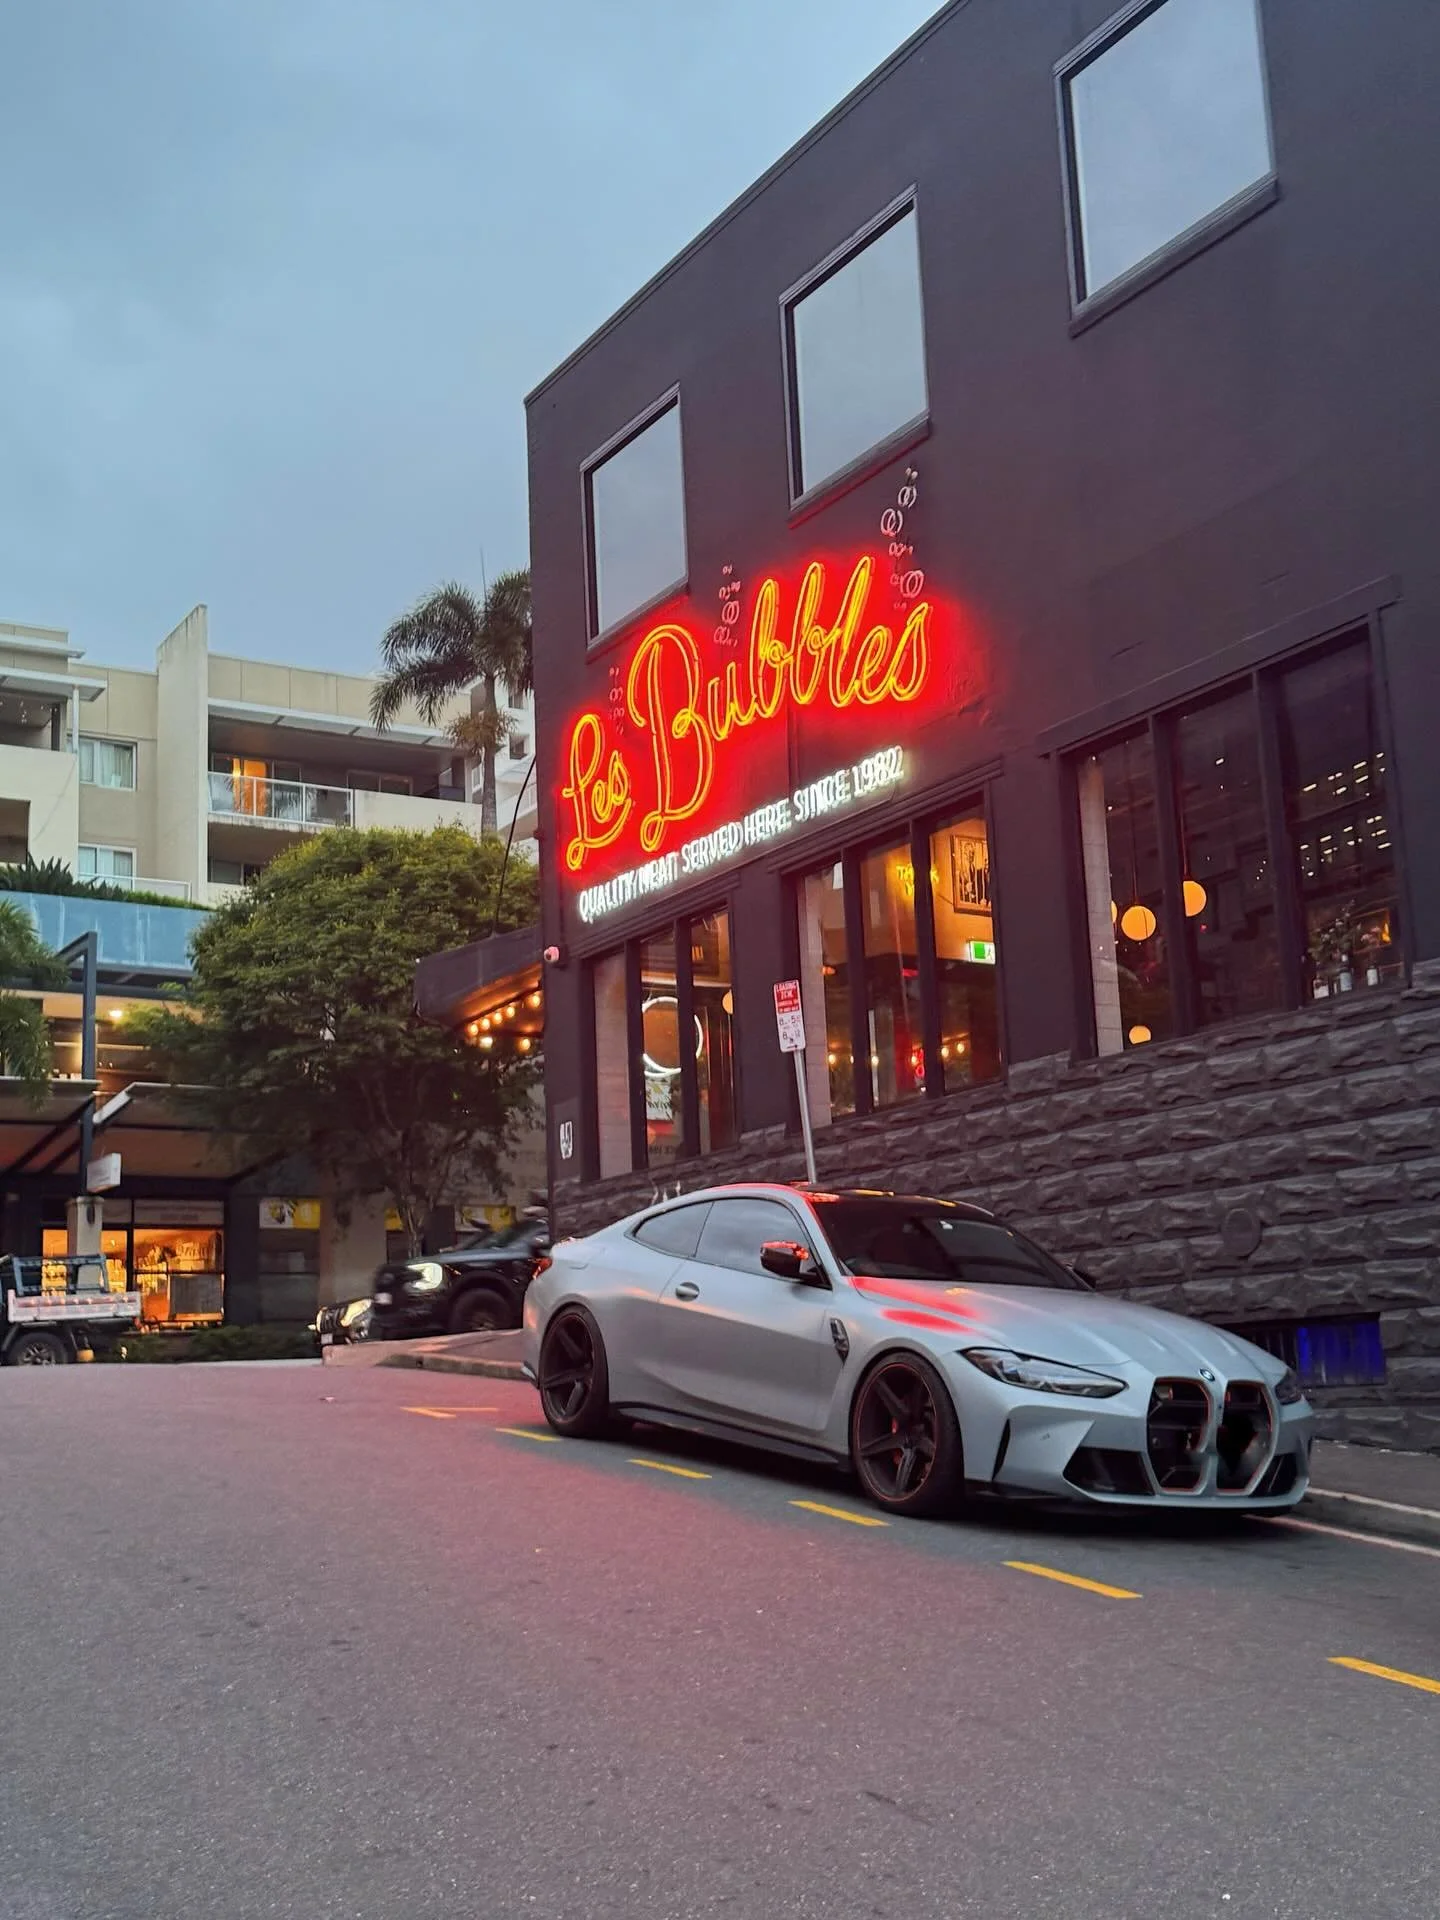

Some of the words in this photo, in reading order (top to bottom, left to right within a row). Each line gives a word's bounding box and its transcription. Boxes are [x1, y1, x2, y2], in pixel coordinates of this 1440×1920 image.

[562, 714, 633, 869] Les
[627, 556, 931, 852] Bubbles
[579, 869, 636, 923] QUALITY
[681, 822, 743, 873] SERVED
[744, 798, 792, 846] HERE
[793, 769, 851, 822] SINCE
[851, 745, 904, 797] 1982
